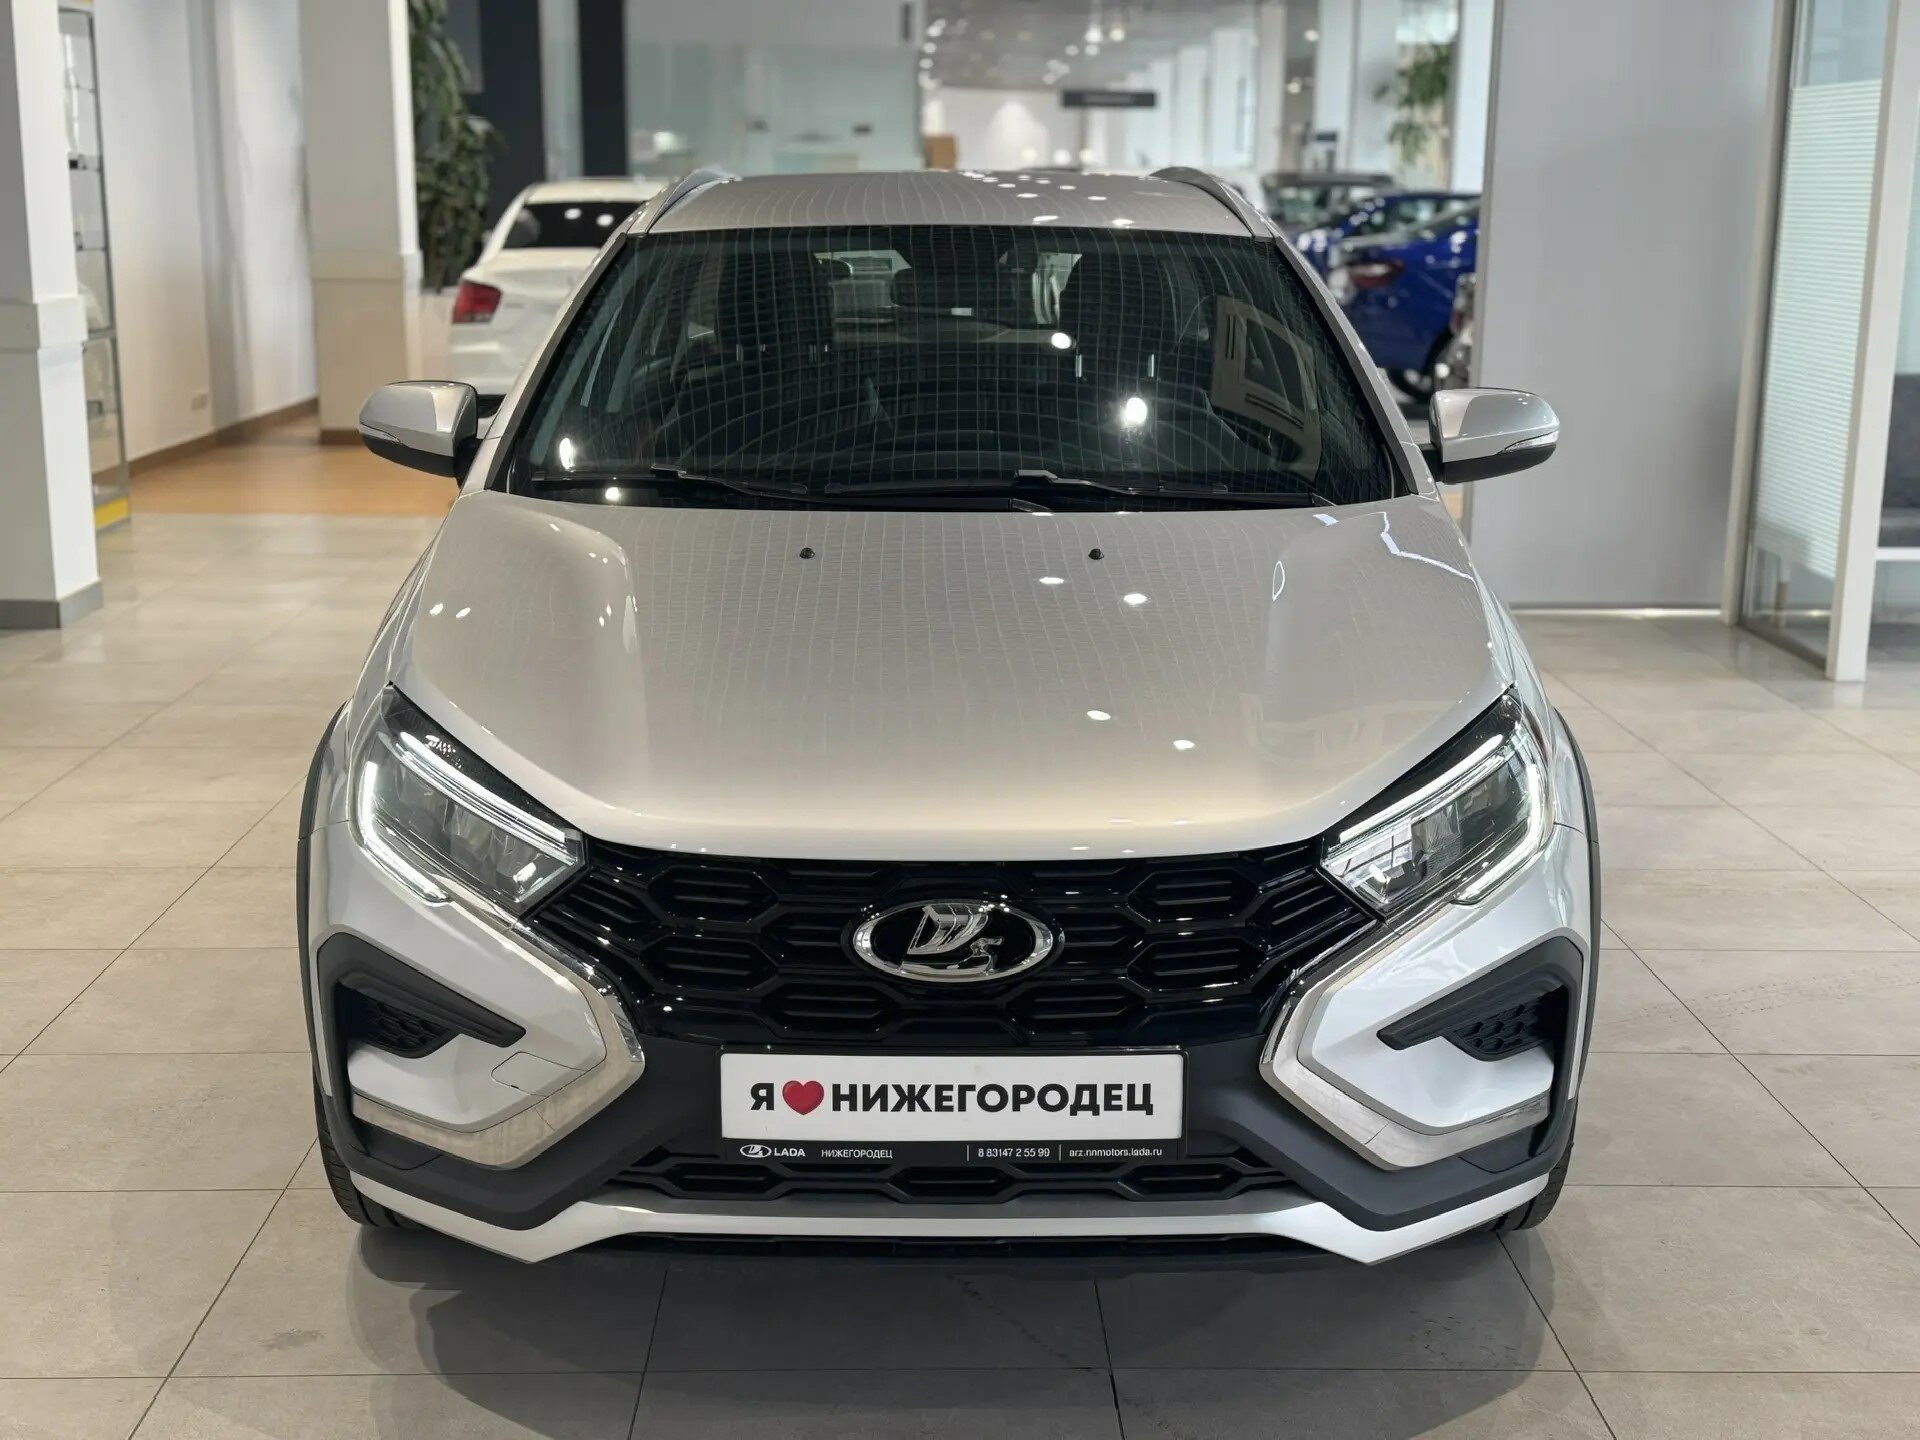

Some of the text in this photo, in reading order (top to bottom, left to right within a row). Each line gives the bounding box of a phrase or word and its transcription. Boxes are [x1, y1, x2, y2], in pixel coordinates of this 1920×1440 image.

[750, 1082, 1153, 1116] Я НИЖЕГОРОДЕЦ
[773, 1147, 806, 1157] LADA
[821, 1148, 893, 1159] НИЖЕГОРОДЕЦ
[977, 1147, 984, 1158] 8
[1015, 1147, 1022, 1158] 2
[1023, 1147, 1036, 1158] 55
